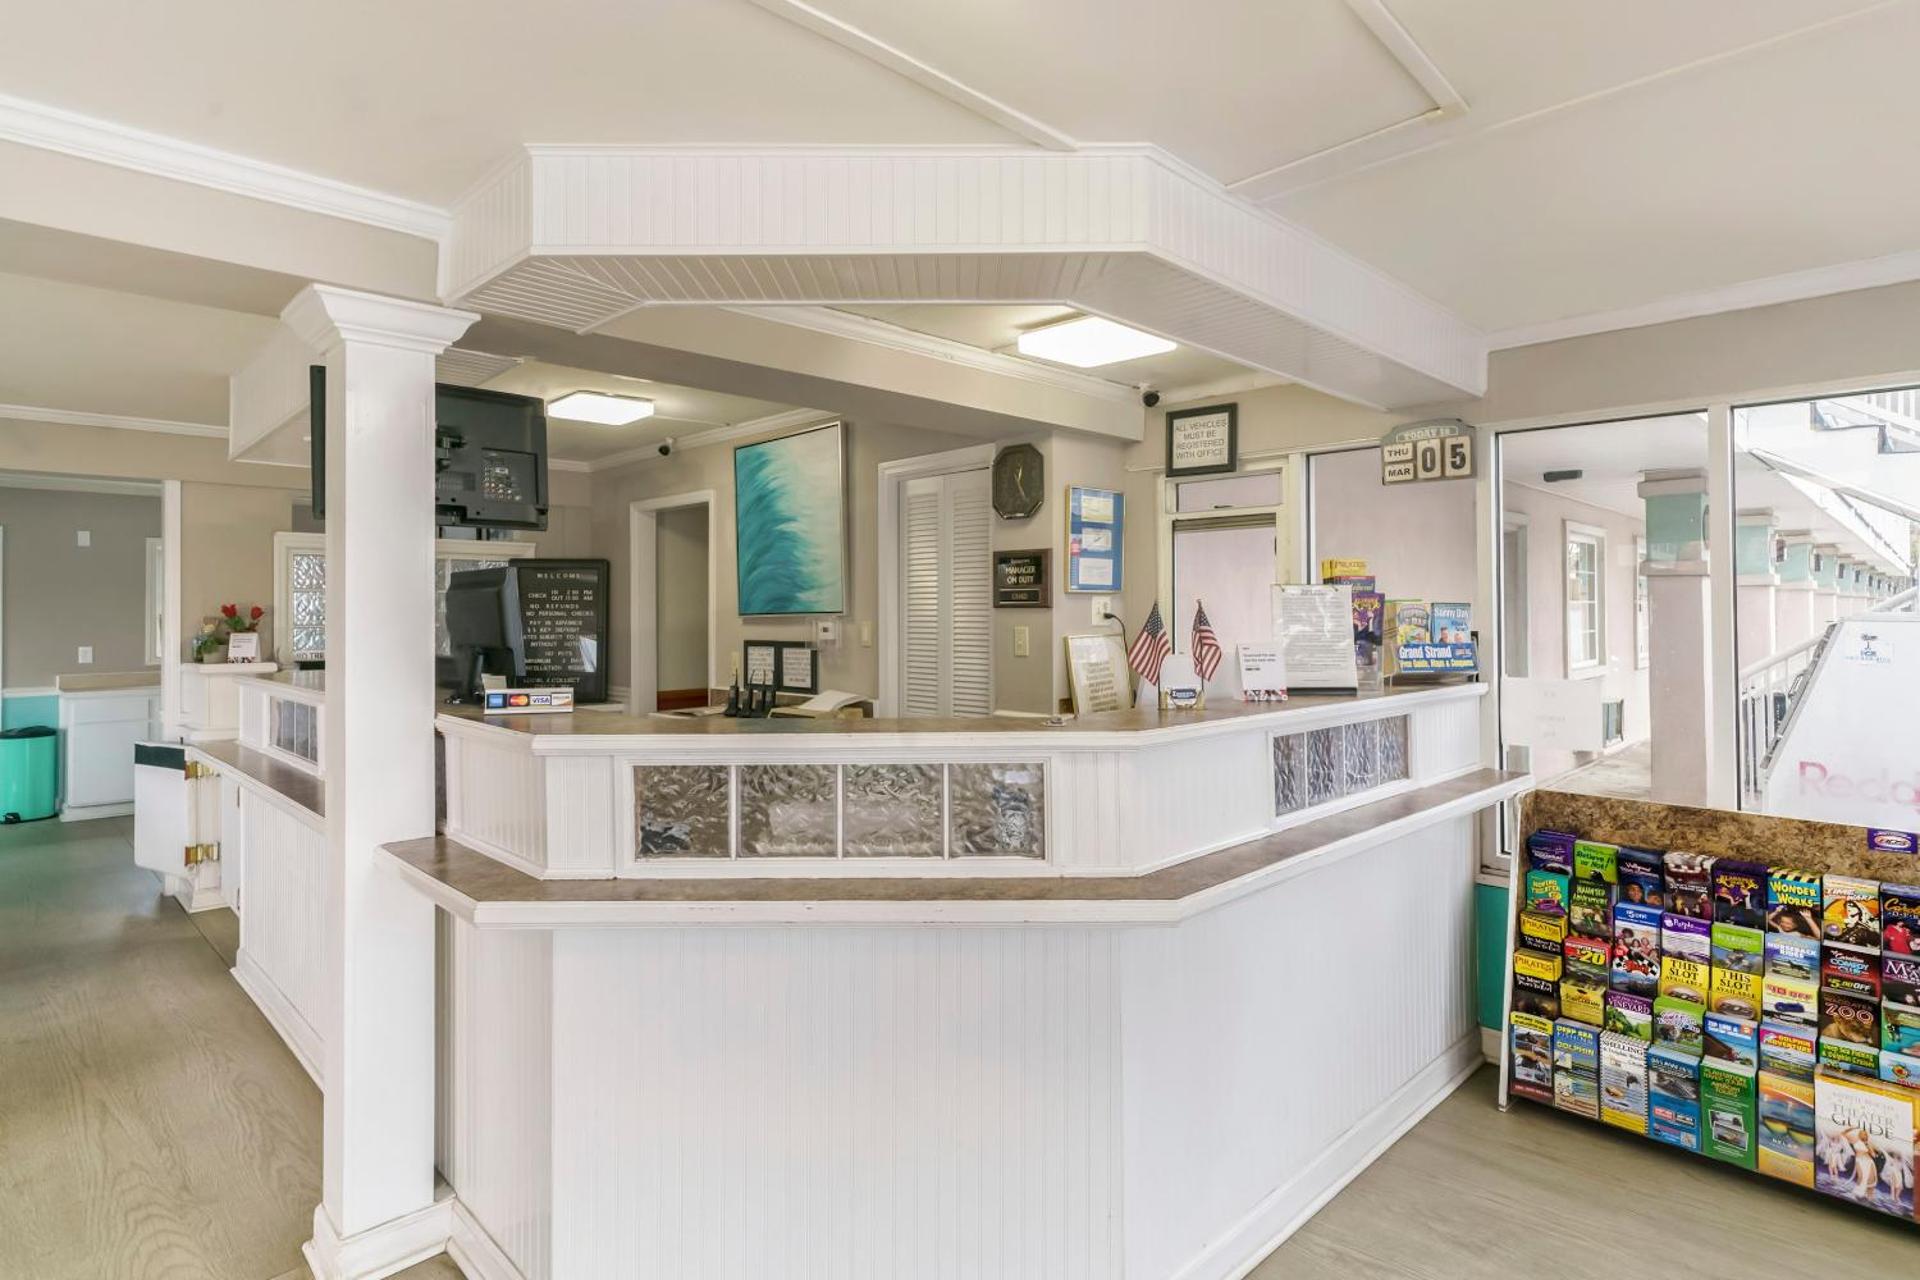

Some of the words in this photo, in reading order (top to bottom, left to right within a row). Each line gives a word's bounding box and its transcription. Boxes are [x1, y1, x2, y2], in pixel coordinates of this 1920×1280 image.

[1175, 422, 1189, 431] ALL
[1190, 420, 1228, 430] VEHICLES
[1183, 431, 1204, 440] MUST
[1206, 430, 1217, 438] BE
[1175, 439, 1225, 449] REGISTERED
[1175, 451, 1195, 459] WITH
[1196, 448, 1225, 457] OFFICE
[1387, 448, 1409, 457] THU
[1388, 467, 1411, 477] MAR
[1005, 565, 1036, 574] MANAGER
[1019, 575, 1034, 584] DUTY
[1399, 646, 1424, 659] Grand
[1425, 645, 1453, 658] Strand
[532, 695, 551, 704] VISA
[1769, 881, 1817, 898] WONDER
[1777, 893, 1814, 908] WORKS
[1671, 959, 1699, 972] THIS
[1669, 967, 1699, 981] SLOT
[1721, 969, 1751, 983] THIS
[1719, 978, 1752, 991] SLOT
[1716, 986, 1755, 999] AVAILABLE
[1607, 998, 1651, 1015] VINEYARD
[1826, 1003, 1874, 1023] ZOO
[1833, 1102, 1895, 1128] THEATER
[1831, 1114, 1895, 1140] GUIDE
